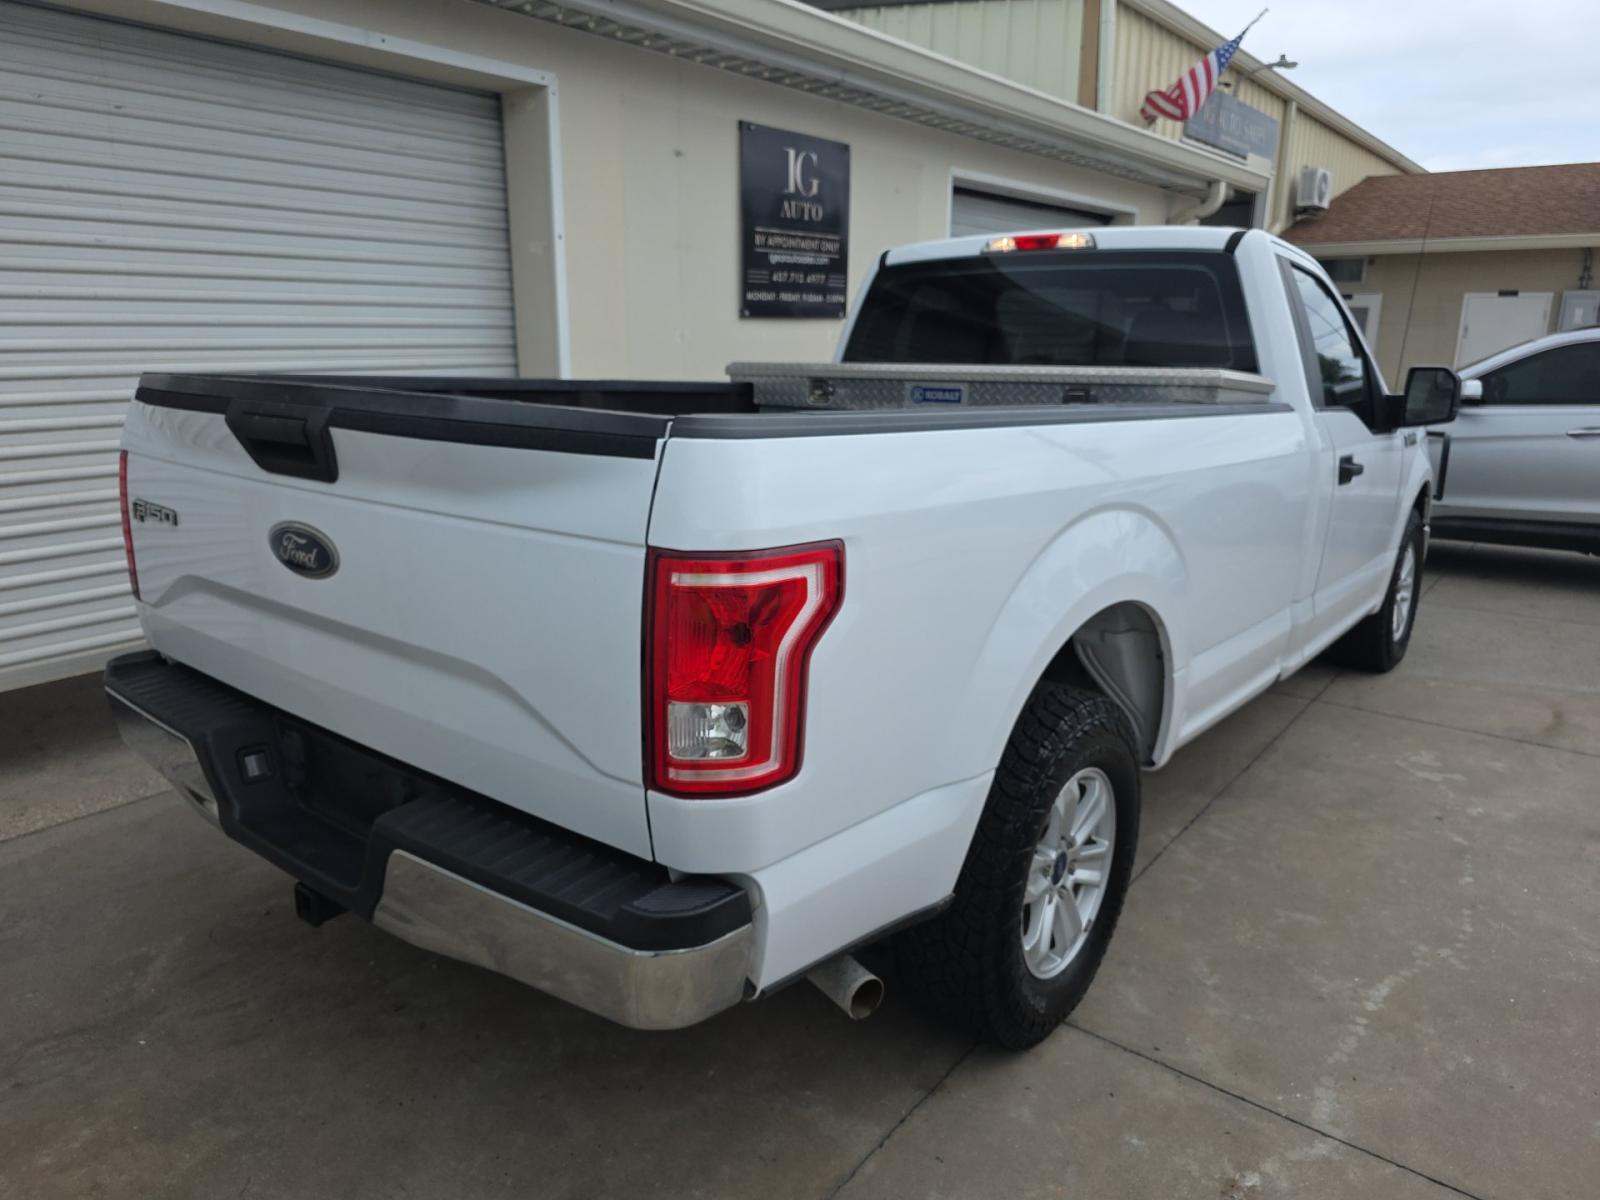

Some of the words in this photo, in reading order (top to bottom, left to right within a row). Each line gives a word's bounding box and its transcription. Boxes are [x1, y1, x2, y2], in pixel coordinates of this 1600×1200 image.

[780, 200, 824, 221] AUTO
[768, 233, 819, 250] APPOINTMENT
[820, 239, 841, 253] ONLY
[278, 532, 318, 569] Ford
